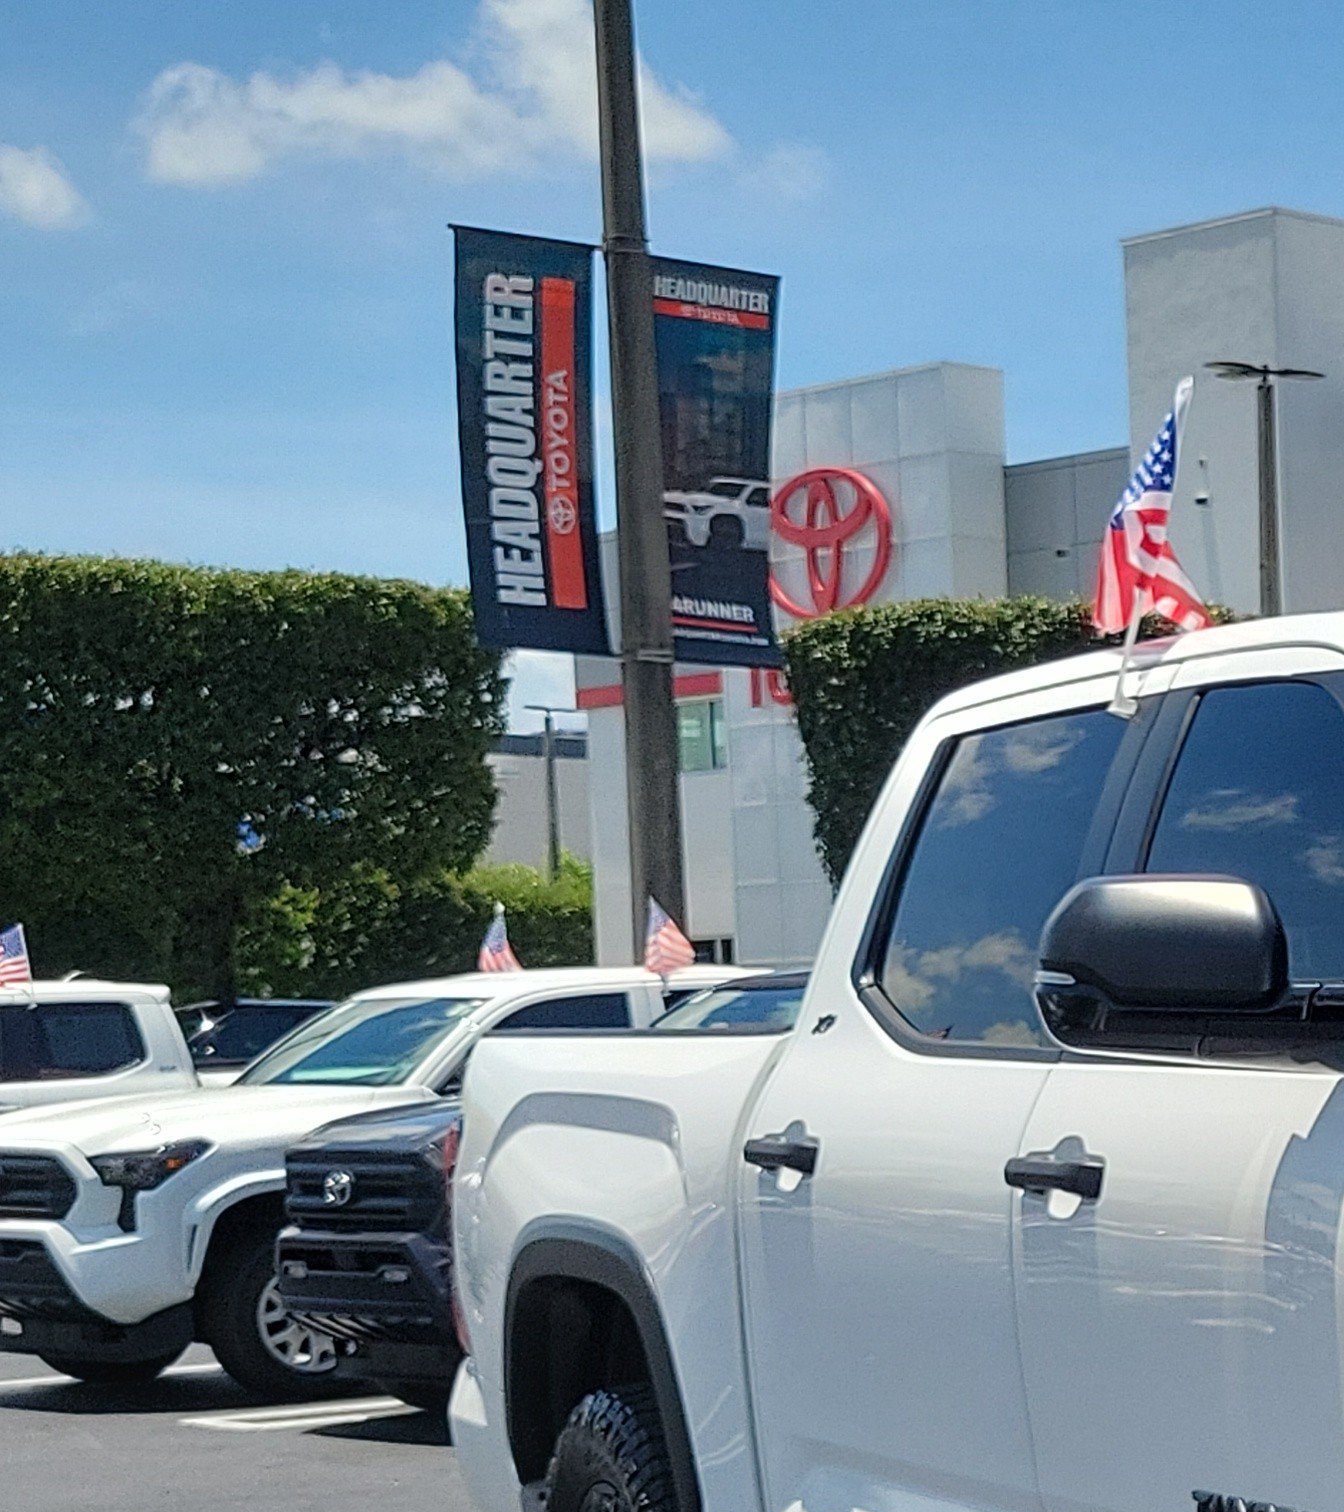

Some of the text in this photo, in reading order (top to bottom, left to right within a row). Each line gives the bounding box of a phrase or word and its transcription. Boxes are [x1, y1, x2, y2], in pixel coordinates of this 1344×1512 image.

[654, 275, 770, 314] HEADQUARTER
[483, 271, 548, 607] HEADQUARTER
[546, 369, 571, 491] TOYOTA
